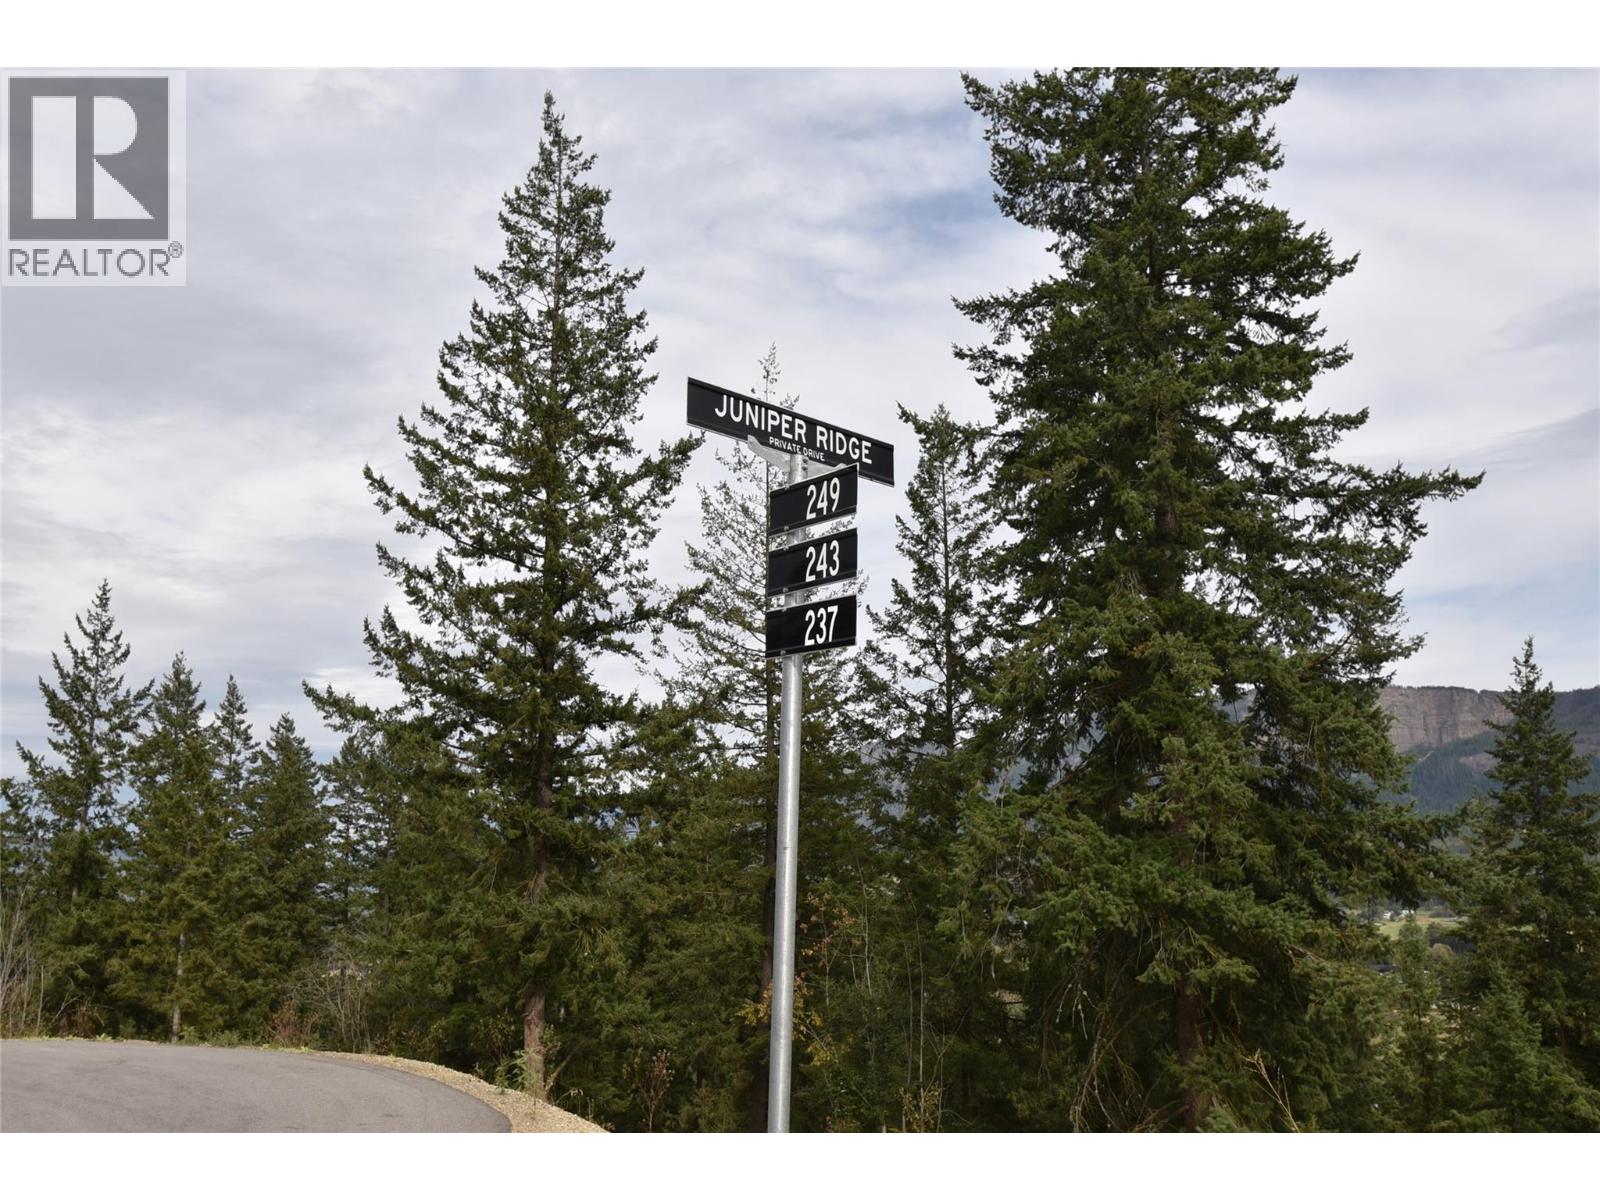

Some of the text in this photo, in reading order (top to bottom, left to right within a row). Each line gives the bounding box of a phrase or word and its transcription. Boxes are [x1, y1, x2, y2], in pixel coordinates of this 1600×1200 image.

[714, 394, 873, 464] JUNIPER RIDGE
[769, 436, 825, 462] PRIVATE DRIVE
[806, 477, 840, 520] 249
[805, 539, 840, 582] 243
[804, 604, 838, 646] 237
